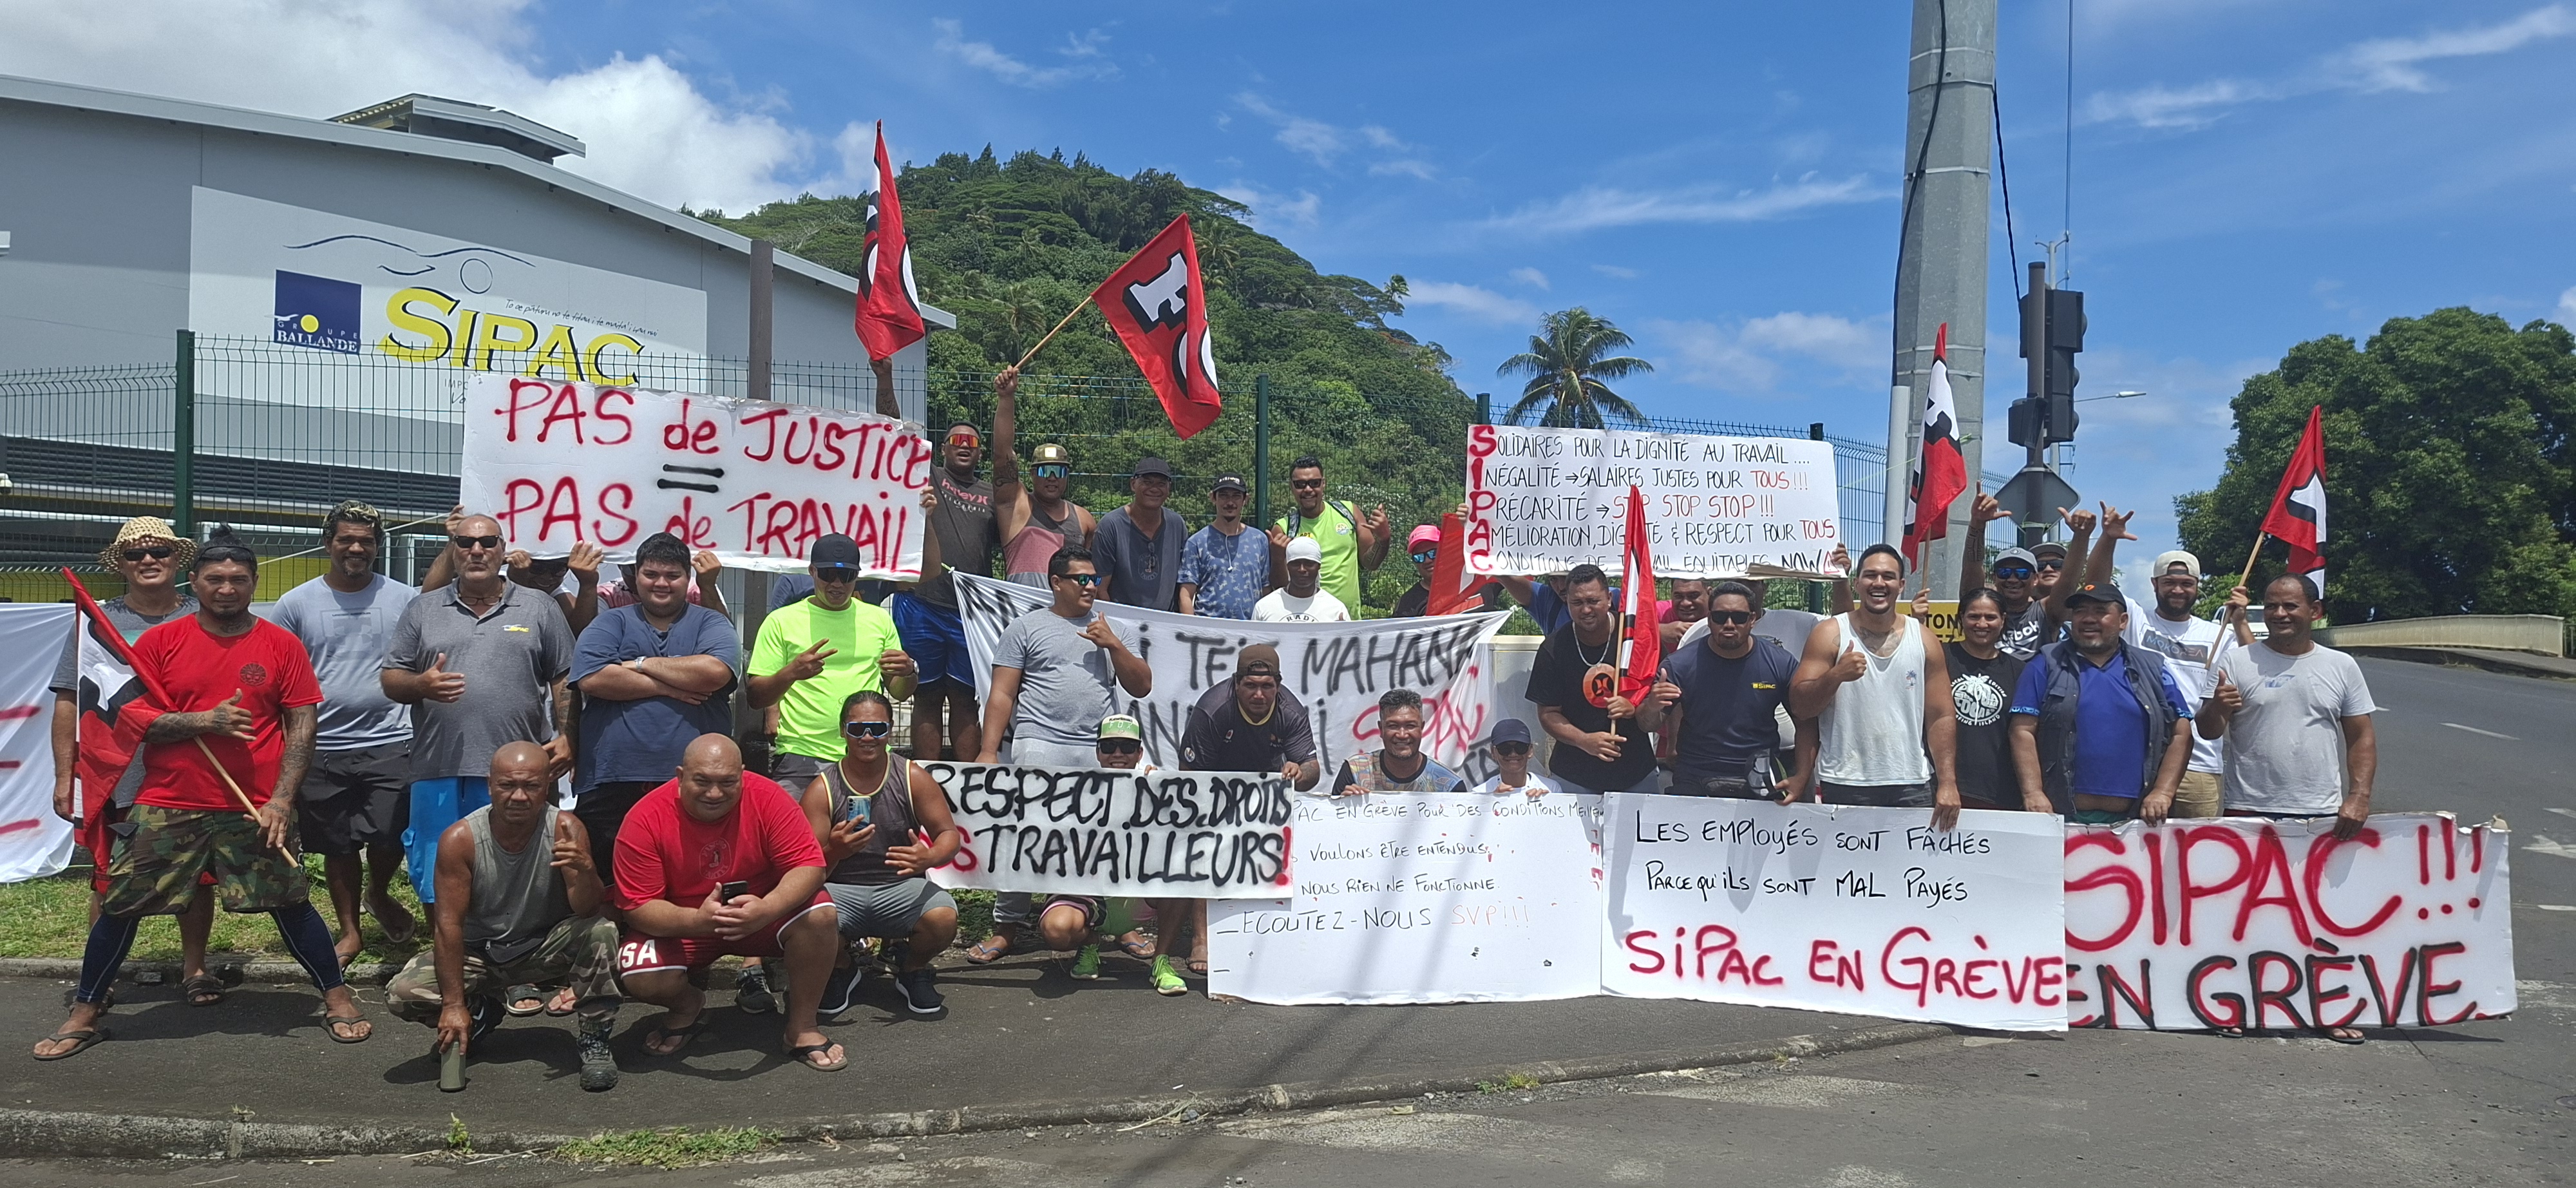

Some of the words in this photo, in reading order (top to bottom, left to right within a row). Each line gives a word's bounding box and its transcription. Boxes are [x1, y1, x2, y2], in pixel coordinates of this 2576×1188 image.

[277, 330, 357, 352] BALLANDE
[376, 287, 645, 387] SIPAC
[495, 378, 634, 445] PAS
[663, 399, 720, 454] de
[1574, 436, 1604, 458] POUR
[1613, 437, 1631, 460] LA
[1703, 445, 1725, 463] AU
[1652, 468, 1700, 489] JUSTES
[1707, 471, 1743, 490] POUR
[496, 475, 638, 547] PAS
[665, 496, 717, 549] de
[1662, 494, 1701, 517] STOP
[1685, 522, 1754, 546] RESPECT
[1763, 522, 1797, 542] POUR
[1799, 519, 1835, 540] TOUS
[1781, 549, 1822, 571] NOW
[1109, 721, 1133, 729] FOX
[925, 763, 1132, 827] RESPECT
[1336, 806, 1357, 819] EN
[1417, 801, 1450, 818] POUR
[1456, 803, 1482, 817] DES
[1636, 809, 1690, 845] LES
[1835, 830, 1891, 852] SONT
[1906, 825, 1991, 856] FÂCHÉS
[1301, 881, 1340, 896] NOUS
[1387, 875, 1405, 893] NE
[1763, 876, 1817, 896] SONT
[1835, 870, 1886, 899] MAL
[2064, 825, 2403, 952] SIPAC
[1810, 939, 1864, 993] EN
[1880, 926, 2065, 1008] GRÈVE
[2067, 957, 2155, 1030] EN
